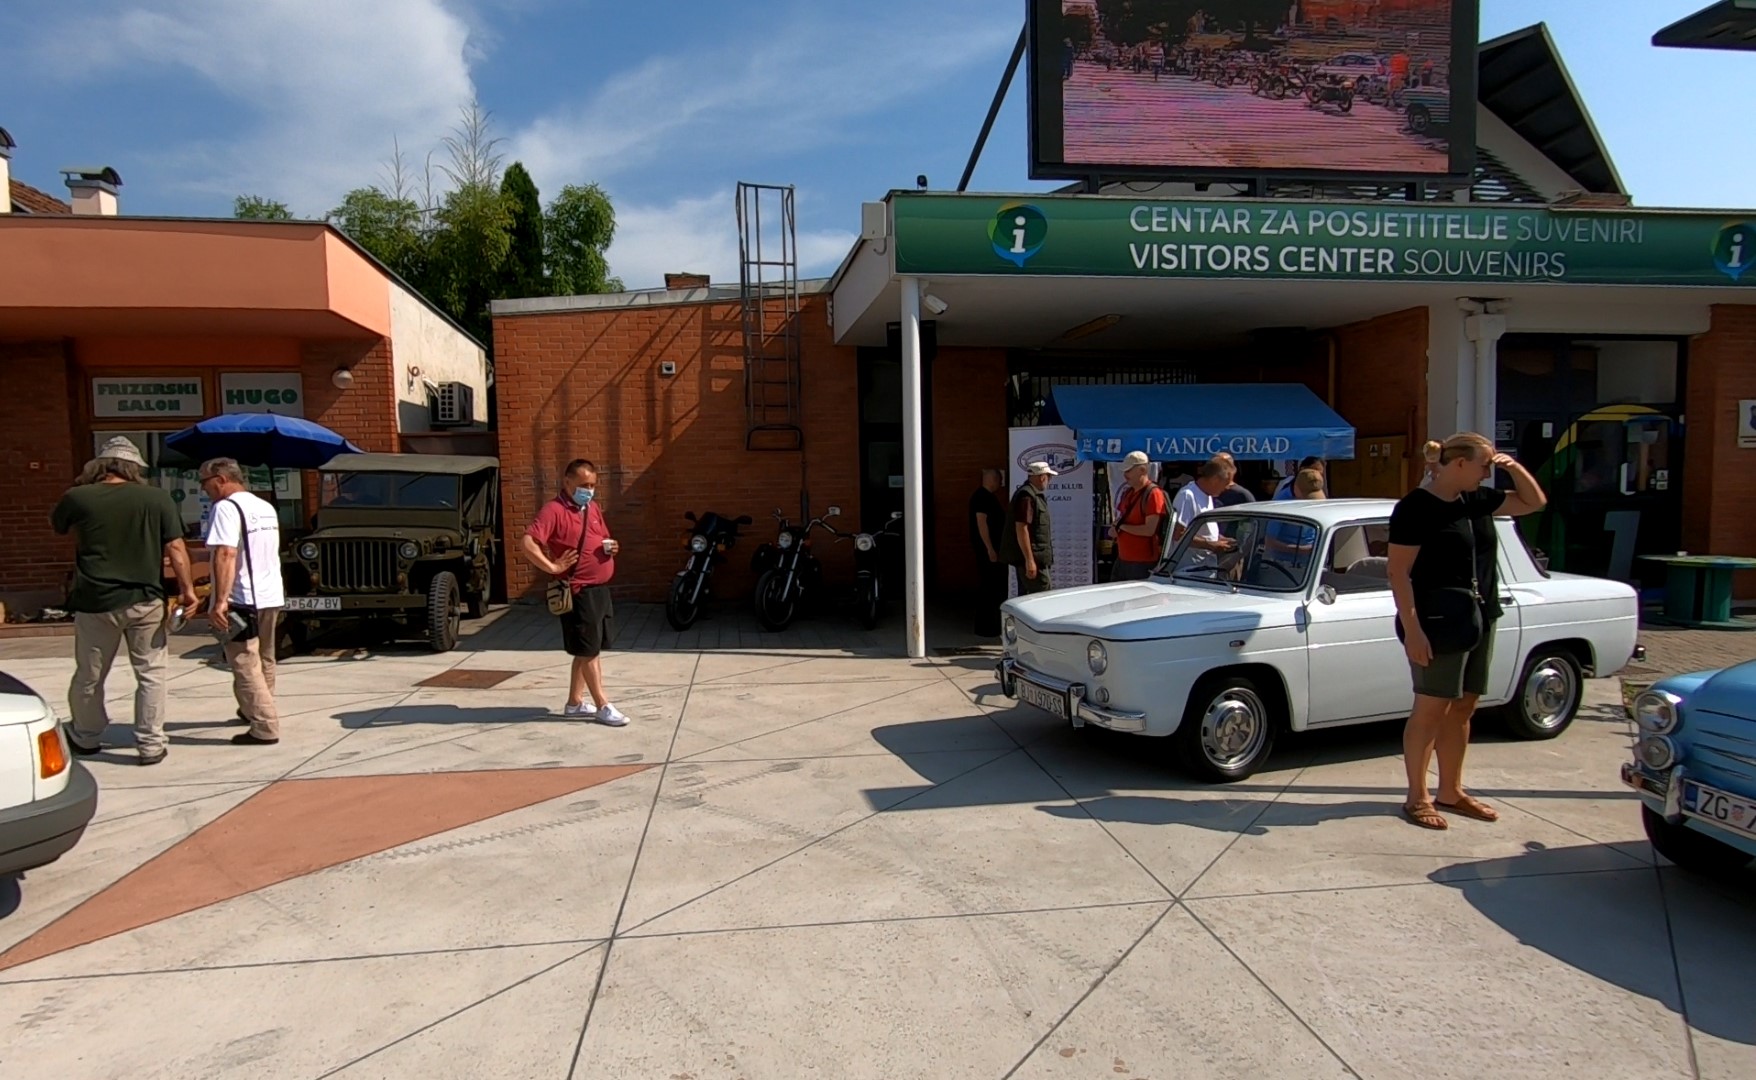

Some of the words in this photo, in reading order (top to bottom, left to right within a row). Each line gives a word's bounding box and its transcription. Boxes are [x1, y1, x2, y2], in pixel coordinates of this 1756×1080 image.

[1130, 205, 1251, 234] CENTAR
[1260, 209, 1300, 235] ZA
[1308, 209, 1508, 240] POSJETITELJE
[1516, 216, 1643, 244] SUVENIRI
[1129, 243, 1270, 271] VISITORS
[1278, 245, 1394, 274] CENTER
[1402, 248, 1566, 277] SOUVENIRS
[97, 383, 198, 395] FRIZERSKI
[225, 389, 298, 405] HUGO
[117, 400, 180, 411] SALON
[1700, 790, 1729, 820] ZG
